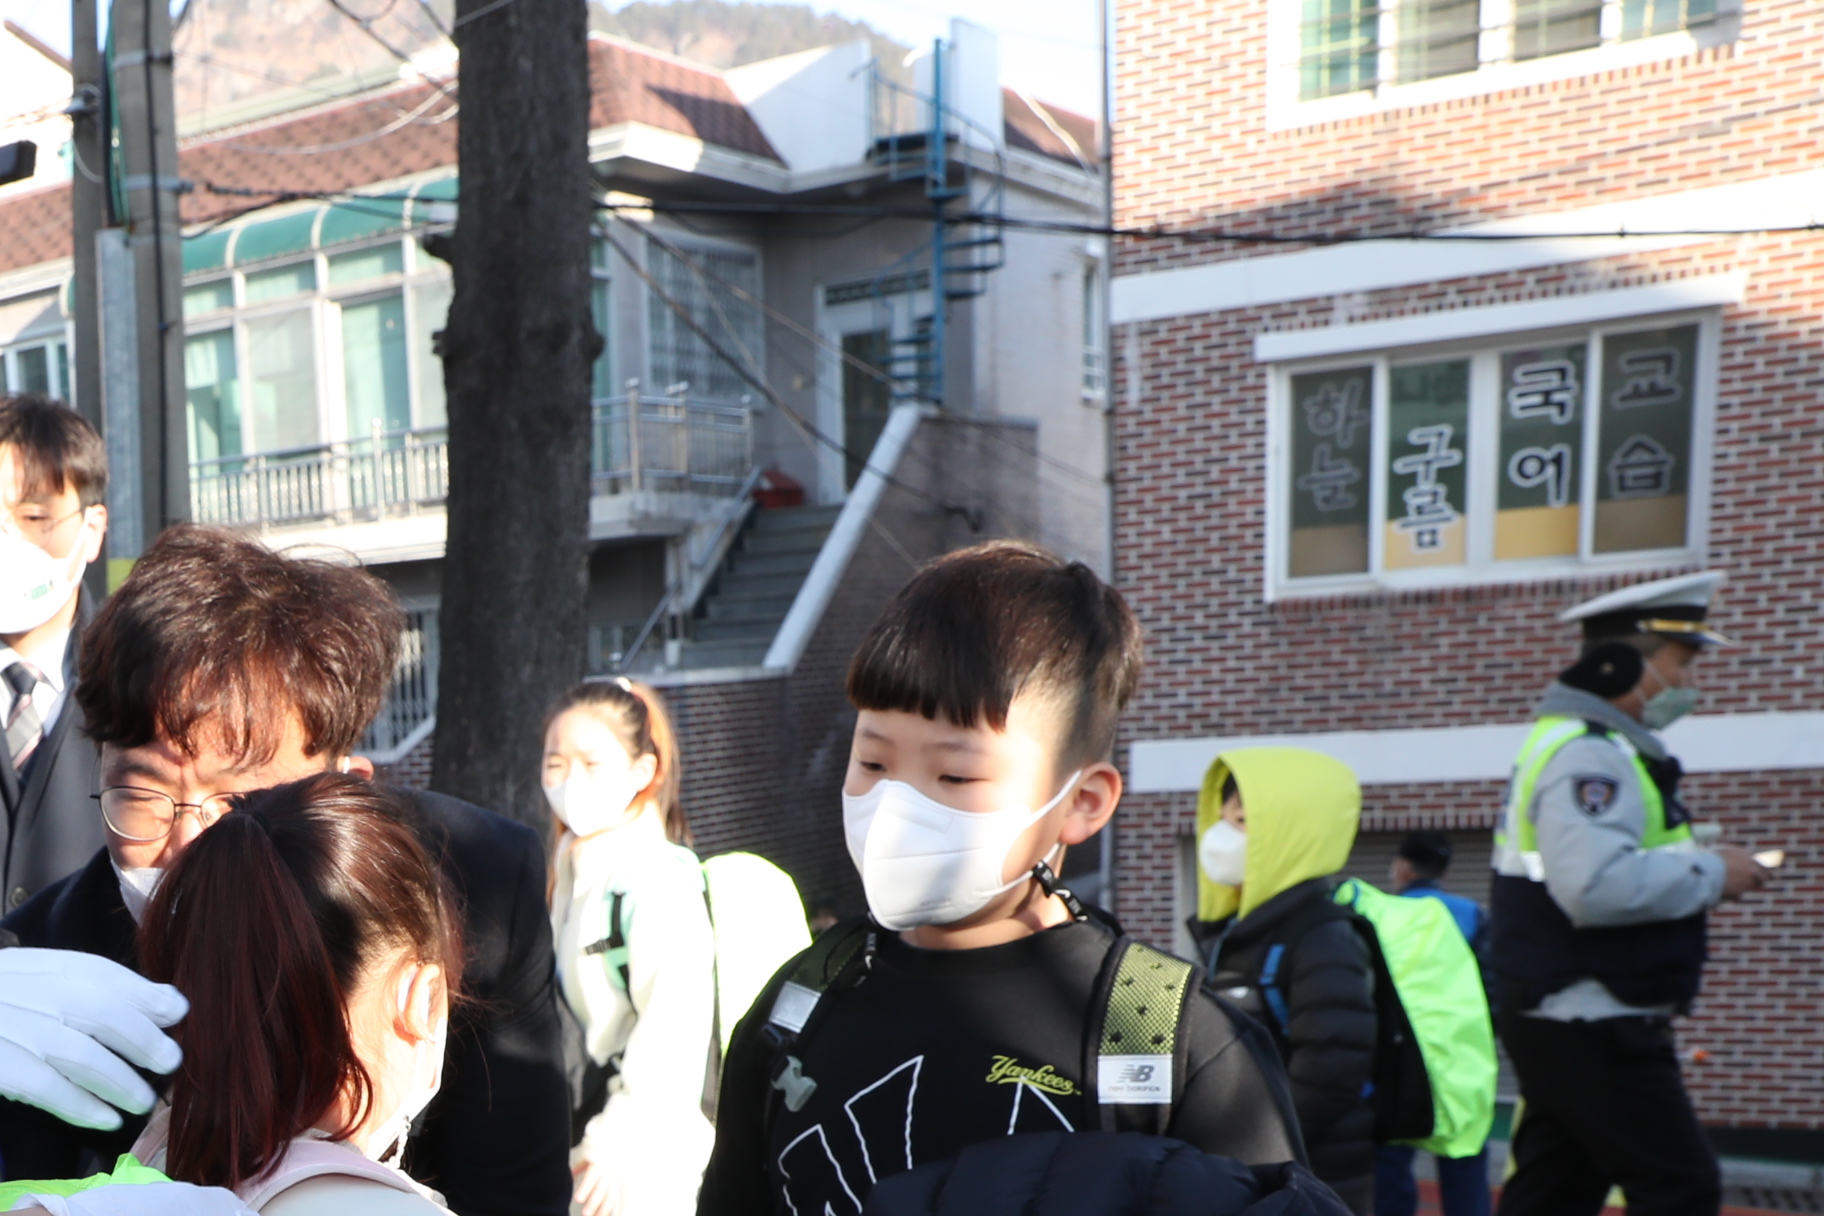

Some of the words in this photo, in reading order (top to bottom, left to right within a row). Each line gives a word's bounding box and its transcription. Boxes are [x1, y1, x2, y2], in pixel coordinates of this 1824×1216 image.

[1297, 378, 1367, 511] 하늘
[1393, 424, 1462, 551] 구름
[1508, 361, 1578, 507] 국어
[1609, 347, 1681, 498] 교습
[985, 1055, 1074, 1095] Yankees
